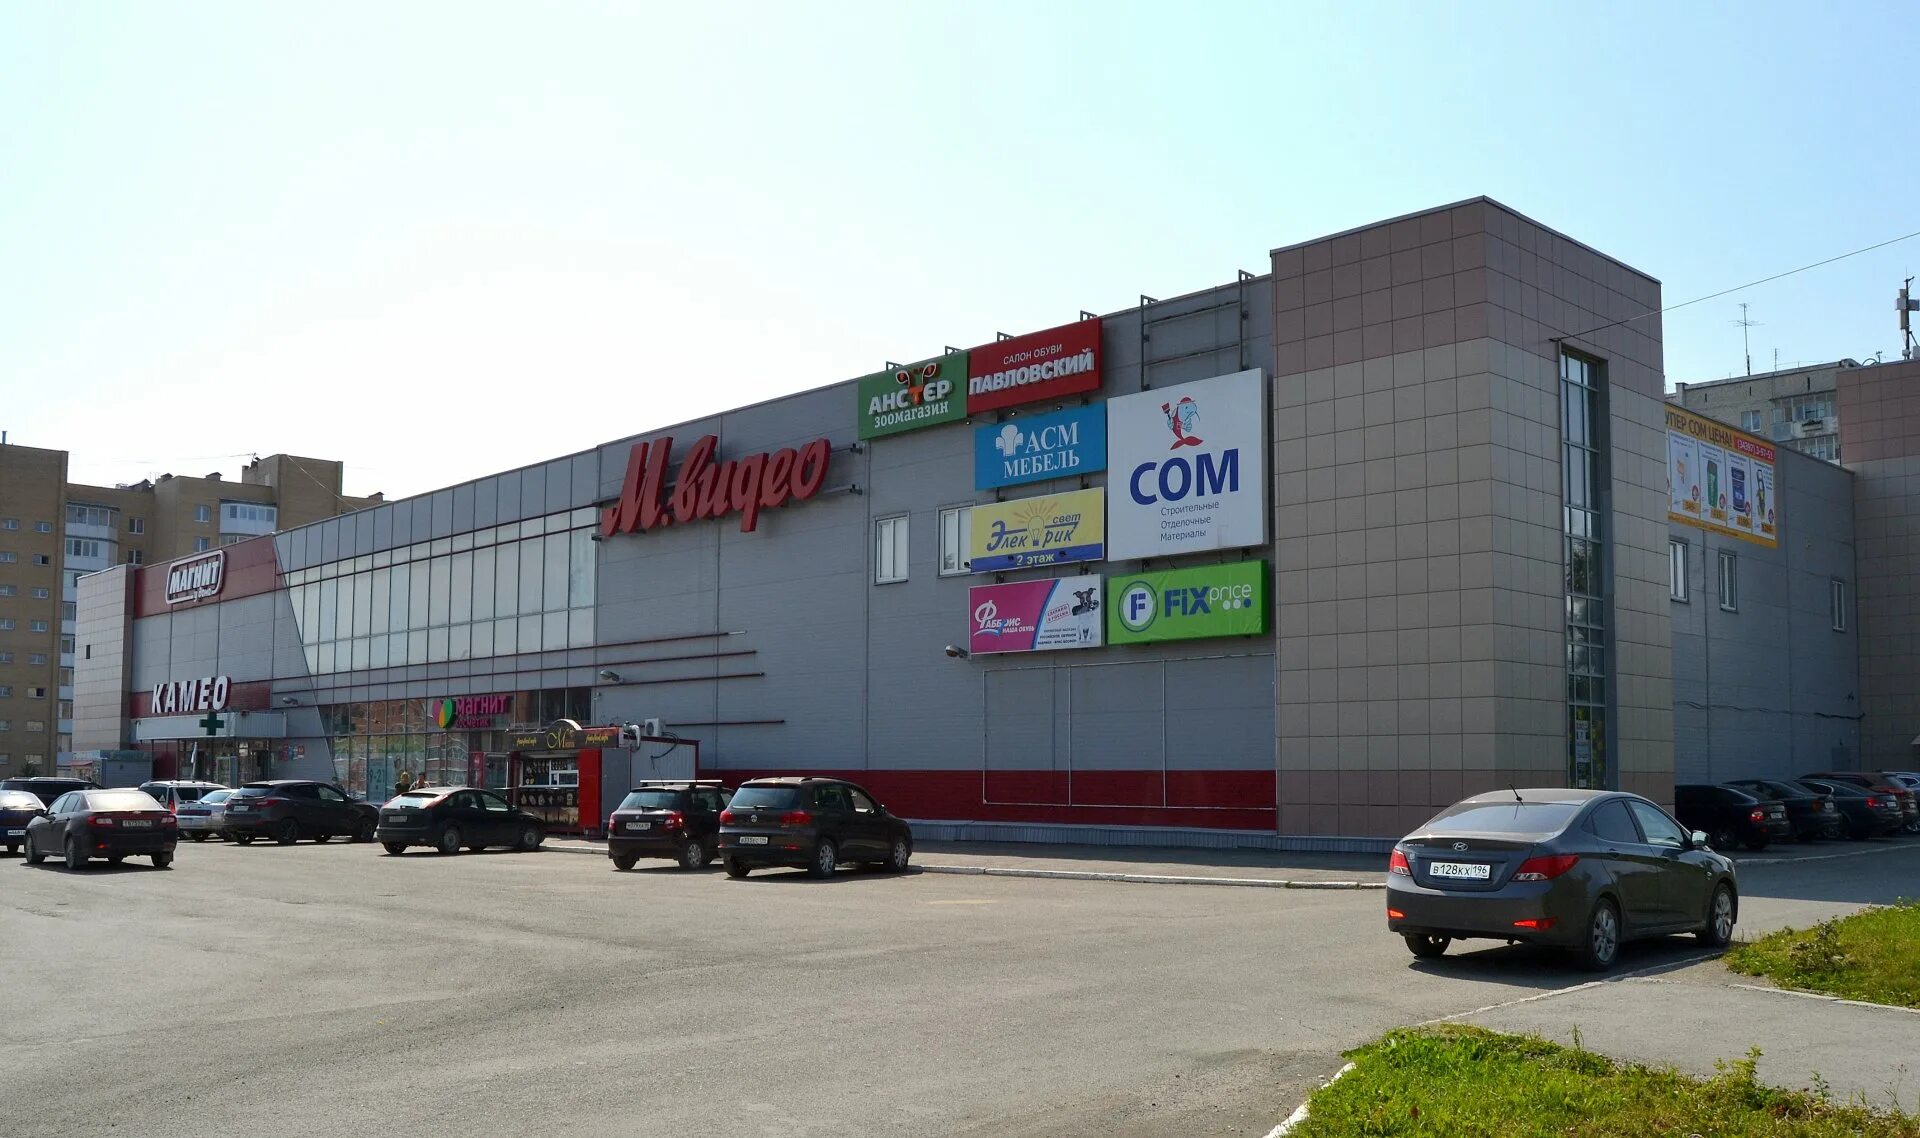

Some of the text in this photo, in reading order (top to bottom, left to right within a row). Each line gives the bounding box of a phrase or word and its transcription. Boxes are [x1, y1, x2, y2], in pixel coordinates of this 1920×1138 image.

[1003, 343, 1062, 365] САЛОН ОБУВИ
[968, 348, 1094, 395] ПАВЛОВСКИЙ
[874, 399, 949, 429] зоомагазин
[1665, 410, 1686, 430] УПЕР
[1688, 419, 1707, 438] СОМ
[1026, 422, 1079, 453] АСМ
[1004, 449, 1080, 479] МЕБЕЛЬ
[1129, 448, 1239, 506] СОМ
[601, 434, 832, 537] М.видео
[1052, 511, 1081, 525] свет
[1160, 500, 1220, 518] Строительные
[1160, 515, 1212, 531] Отделочные
[1160, 528, 1207, 543] Материалы
[1016, 552, 1055, 566] 2 этаж
[169, 561, 219, 594] МАГНИТ
[1130, 592, 1147, 621] F
[1209, 583, 1252, 604] price
[151, 675, 230, 713] КАМЕО
[1433, 864, 1487, 876] В128КХ 196
